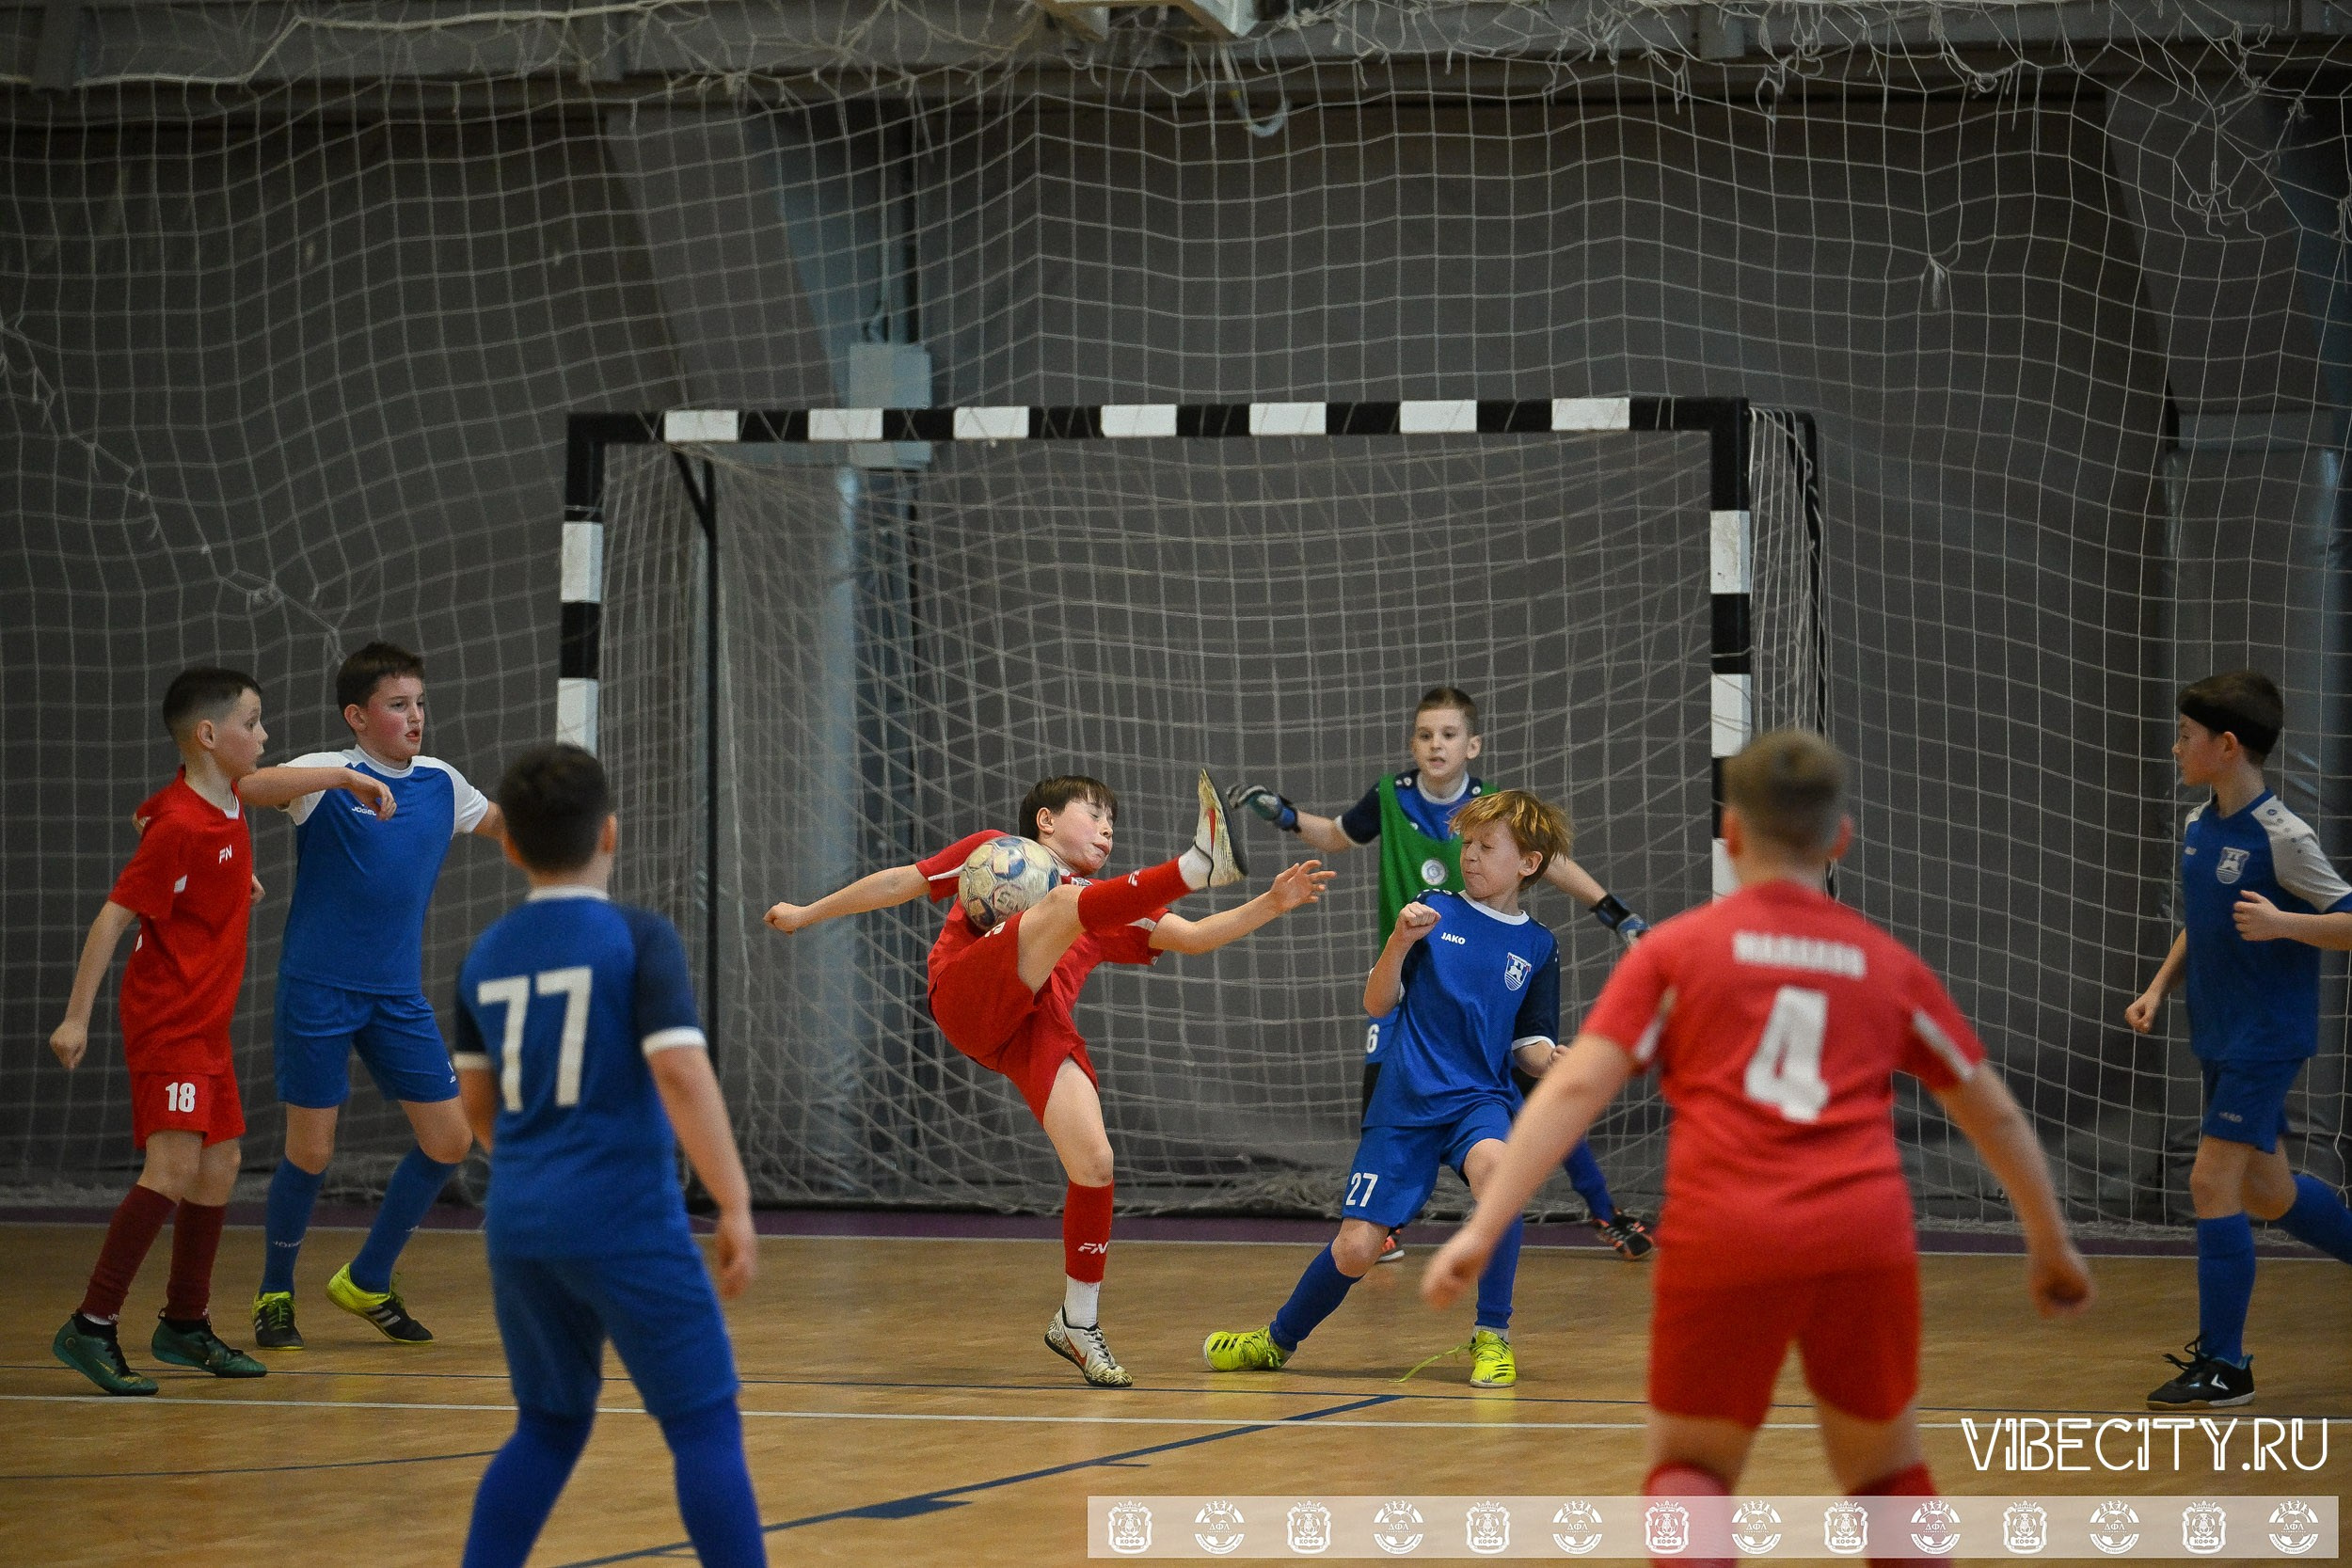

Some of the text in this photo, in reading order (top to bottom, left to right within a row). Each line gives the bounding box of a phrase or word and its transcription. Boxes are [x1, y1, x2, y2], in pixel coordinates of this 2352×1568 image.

[1440, 931, 1466, 945] JAKO
[477, 965, 593, 1112] 77
[1366, 1023, 1380, 1053] 6
[1743, 985, 1830, 1123] 4
[165, 1082, 196, 1113] 18
[1345, 1172, 1378, 1208] 27
